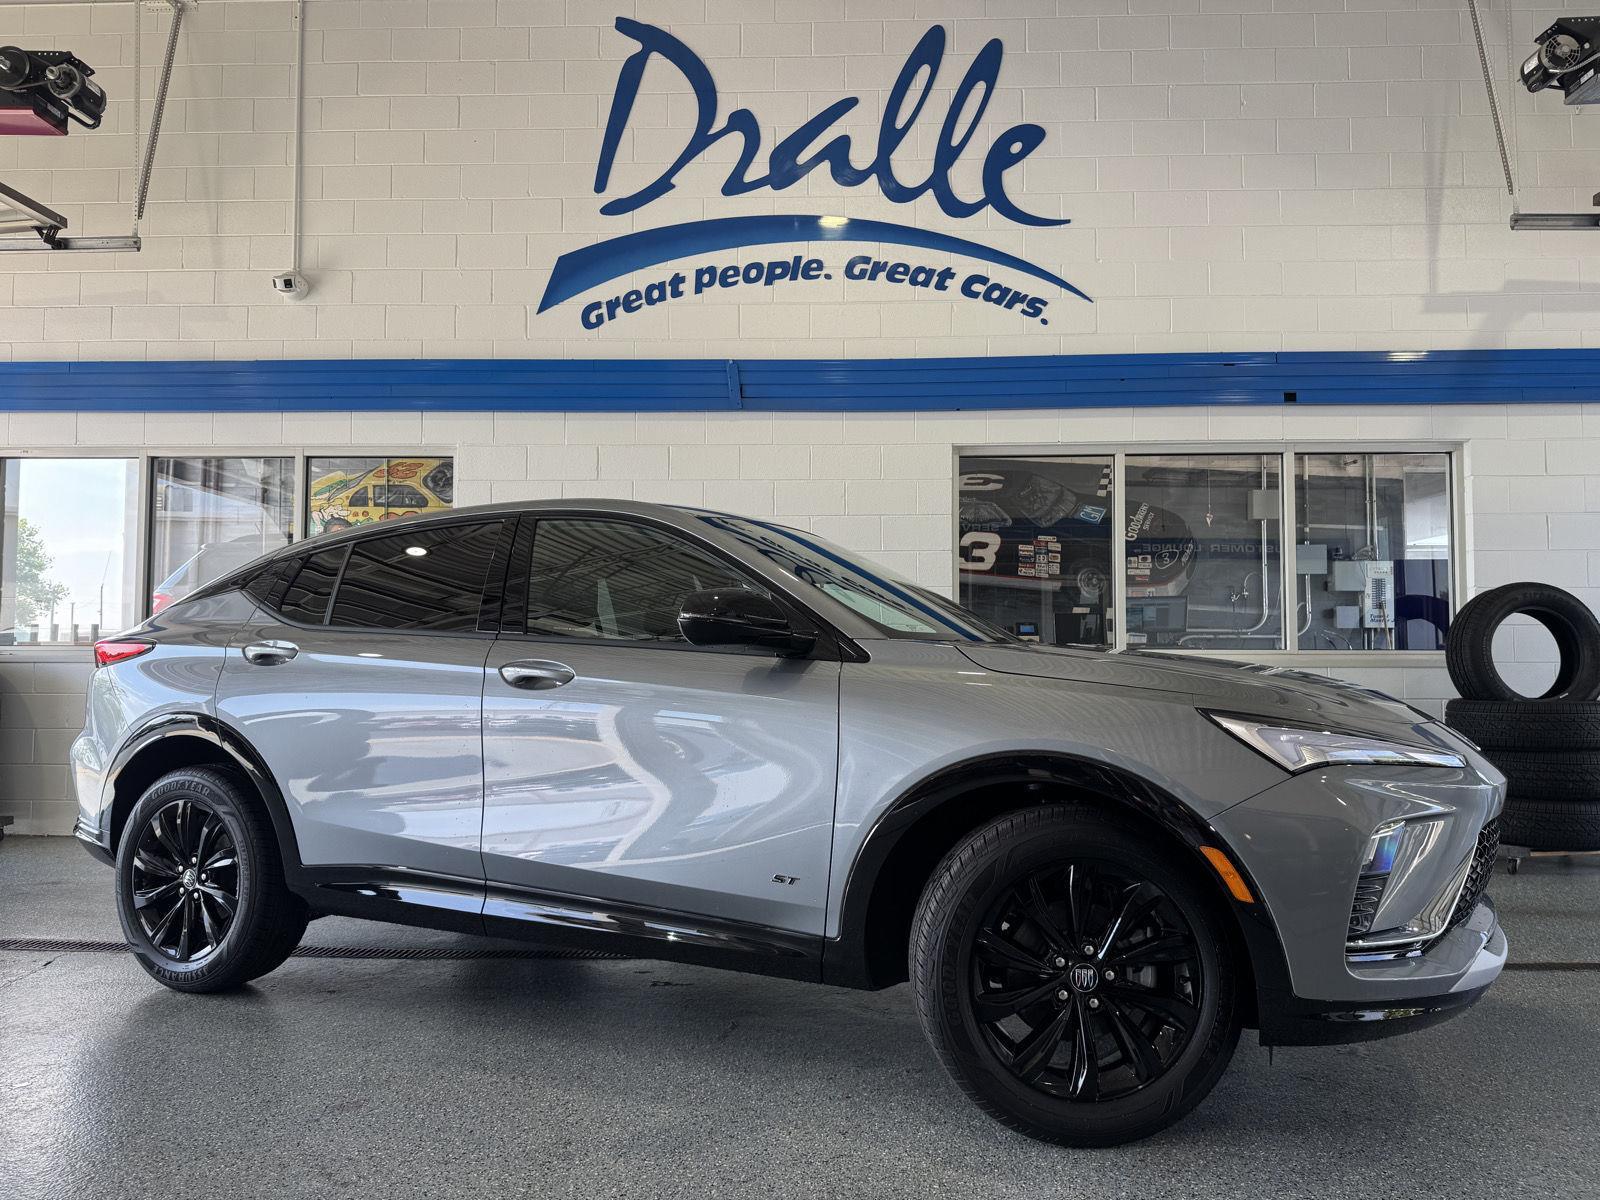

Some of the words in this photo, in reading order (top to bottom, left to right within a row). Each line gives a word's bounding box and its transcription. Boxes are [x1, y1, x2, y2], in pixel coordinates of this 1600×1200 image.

[595, 17, 1070, 227] Dralle
[582, 275, 685, 329] Great
[694, 255, 833, 296] people.
[846, 256, 954, 291] Great
[961, 275, 1049, 326] Cars.
[959, 532, 1001, 571] 3
[1161, 553, 1170, 564] 3
[771, 874, 800, 885] ST
